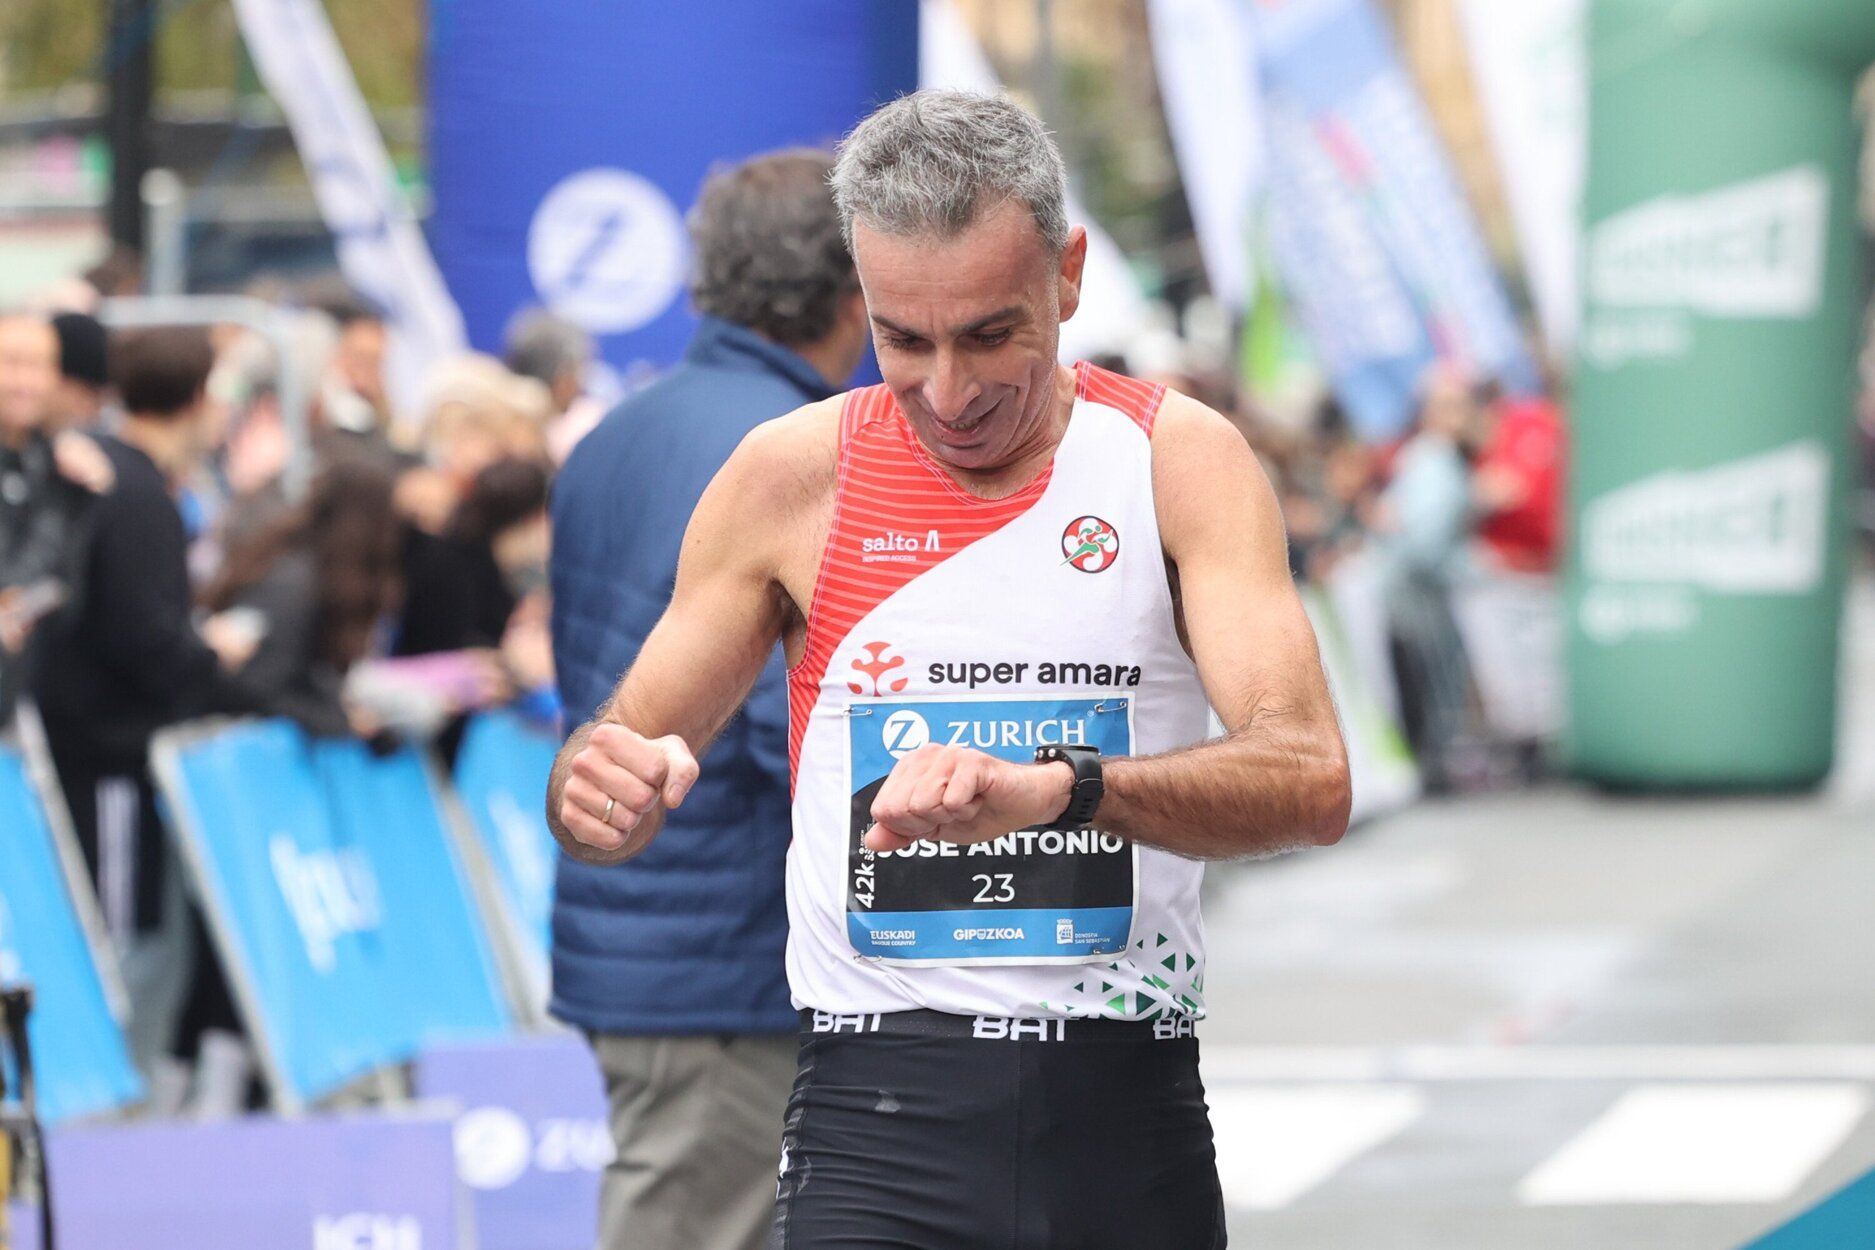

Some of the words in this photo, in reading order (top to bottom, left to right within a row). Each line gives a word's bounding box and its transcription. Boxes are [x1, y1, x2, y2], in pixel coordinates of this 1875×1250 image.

[862, 531, 919, 552] salto
[928, 661, 1029, 689] super
[1037, 661, 1141, 687] amara
[947, 719, 1086, 748] ZURICH
[877, 838, 960, 858] OSE
[967, 831, 1124, 857] ANTONIO
[854, 862, 875, 909] 42k
[971, 873, 1016, 903] 23
[870, 930, 916, 940] EUSKADI
[953, 927, 1025, 941] GIPUZKOA
[972, 1014, 1070, 1041] BAT
